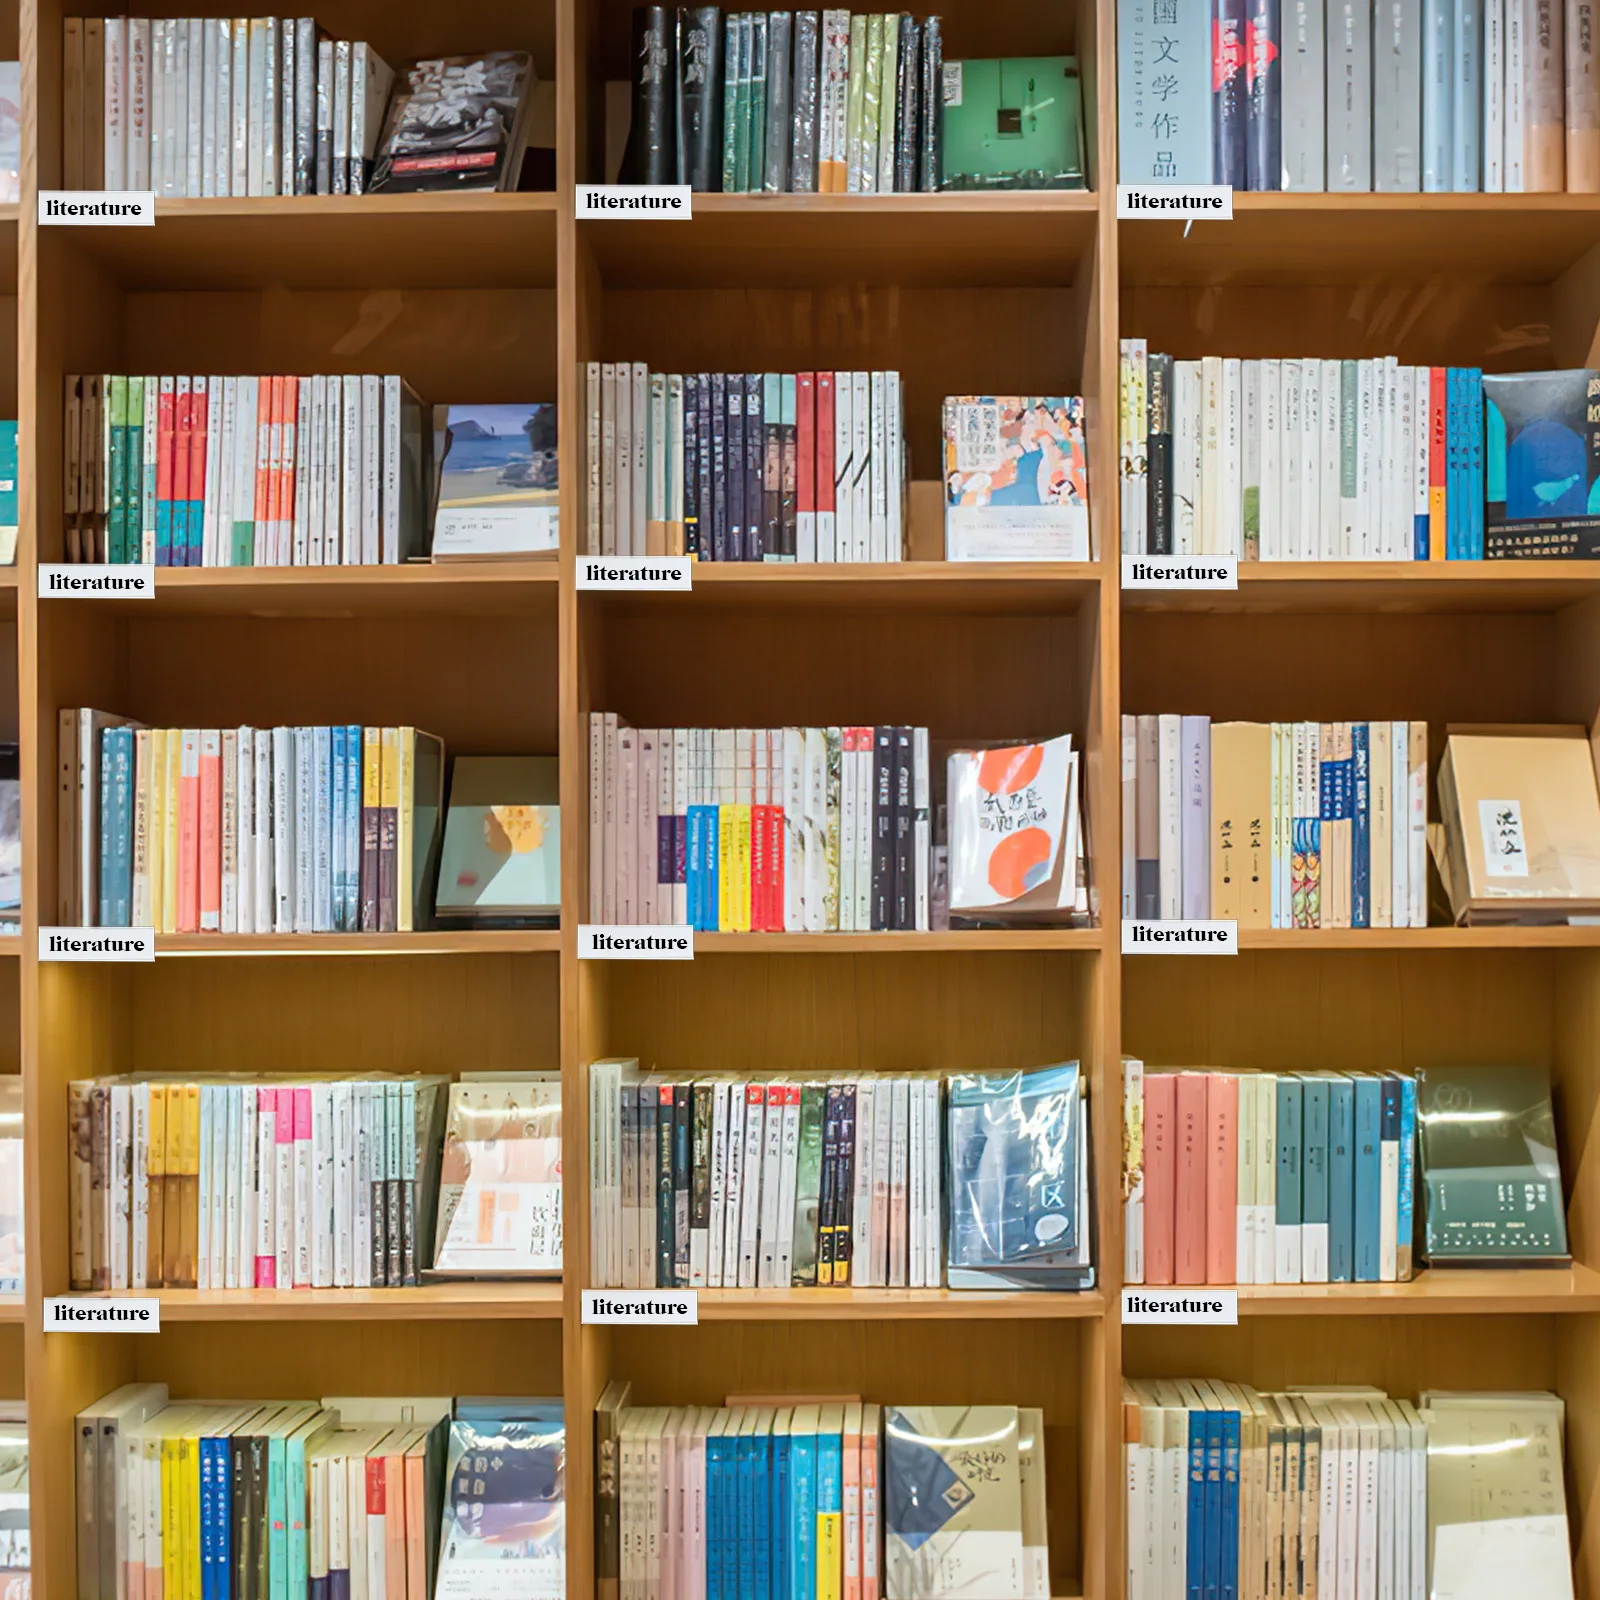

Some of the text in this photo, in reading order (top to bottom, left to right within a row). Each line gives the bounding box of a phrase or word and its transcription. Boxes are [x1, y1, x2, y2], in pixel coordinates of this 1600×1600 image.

[46, 199, 142, 216] literature
[586, 192, 682, 209] literature
[1127, 192, 1223, 209] literature
[586, 564, 682, 581] literature
[1132, 563, 1228, 580] literature
[49, 573, 145, 590] literature
[592, 933, 688, 950] literature
[1132, 925, 1228, 942] literature
[49, 935, 145, 952] literature
[54, 1304, 150, 1321] literature
[592, 1298, 688, 1315] literature
[1127, 1296, 1223, 1313] literature
